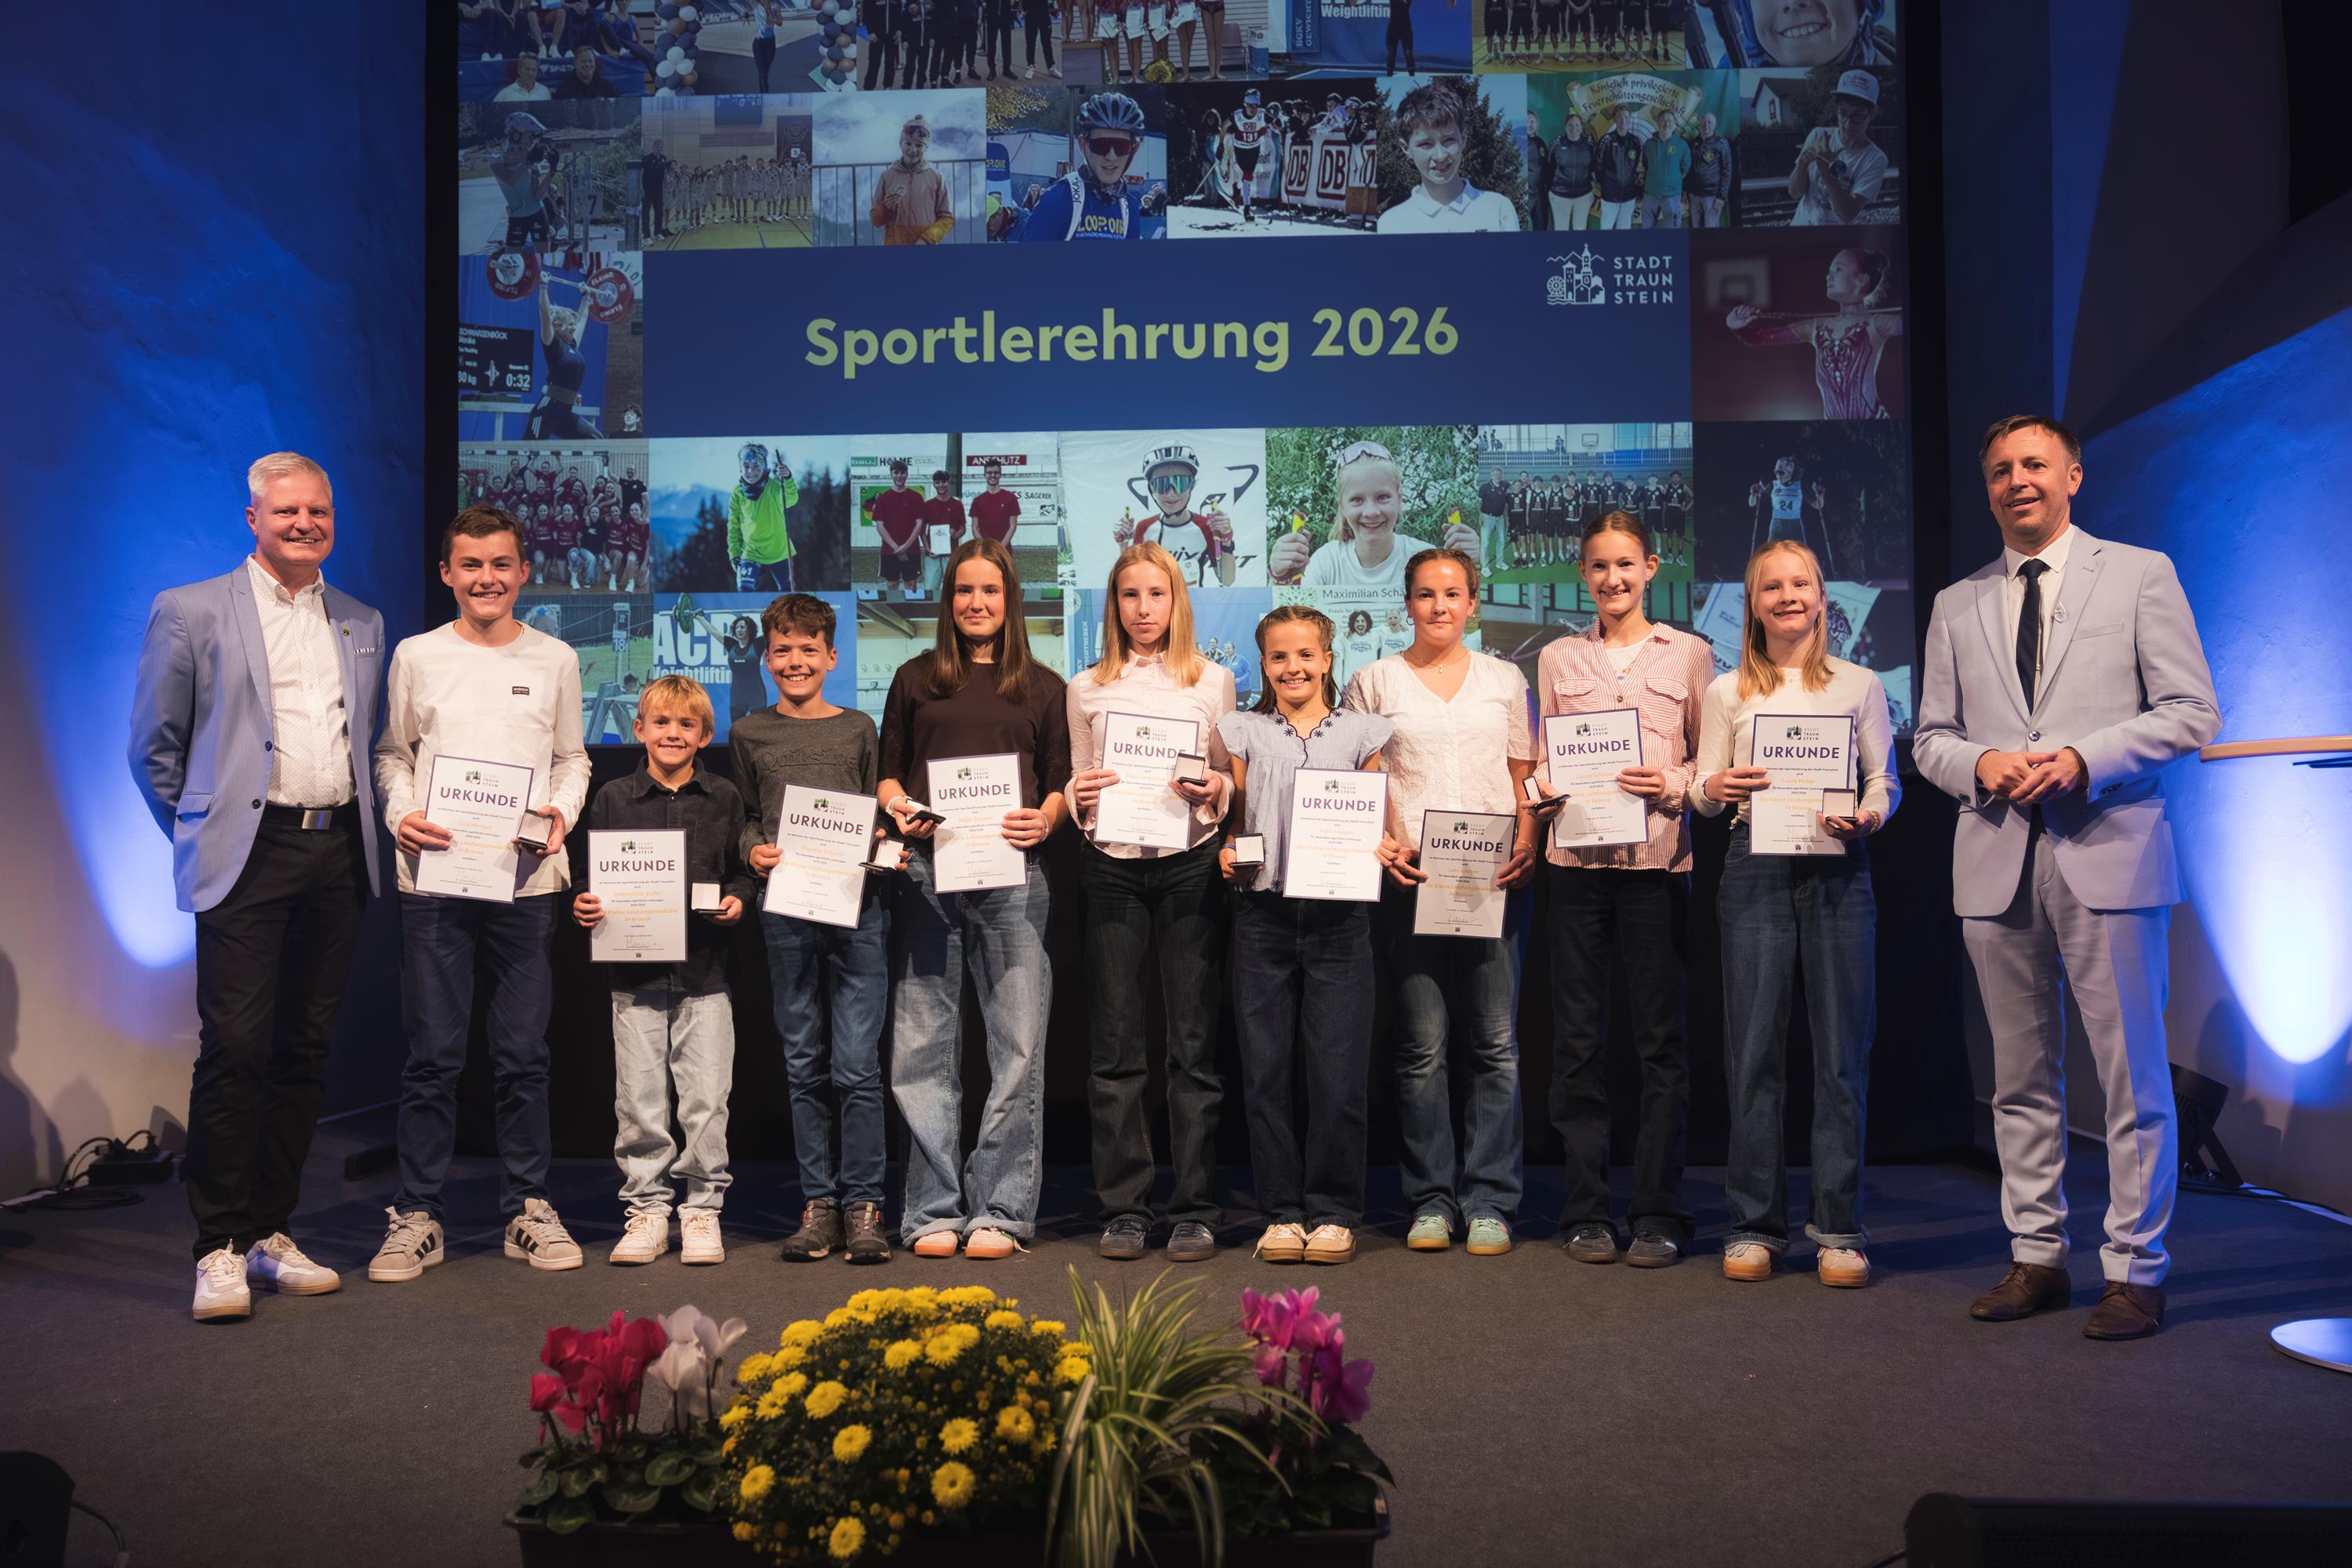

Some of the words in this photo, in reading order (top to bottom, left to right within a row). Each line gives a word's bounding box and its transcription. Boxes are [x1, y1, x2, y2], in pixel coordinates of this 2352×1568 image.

[1320, 5, 1391, 19] Weightliftin
[1590, 78, 1628, 95] Königlich
[1631, 79, 1680, 99] privilegierte
[1582, 91, 1686, 115] Feuerschützengesellschaft
[1243, 133, 1258, 142] 131
[1287, 150, 1308, 186] DB
[1320, 150, 1345, 189] DB
[1613, 256, 1672, 270] STADT
[1613, 273, 1673, 287] TRAUN
[1613, 291, 1673, 304] STEIN
[804, 308, 1290, 379] Sportlerehrung
[1312, 307, 1459, 358] 2026
[506, 372, 531, 388] 0:32
[1780, 501, 1793, 511] 24
[1323, 588, 1378, 599] Maximilian
[1381, 587, 1406, 598] Schä
[613, 638, 626, 652] 18
[653, 666, 732, 684] Weightliftin
[1556, 739, 1631, 756] URKUNDE
[1763, 746, 1839, 759] URKUNDE
[440, 786, 518, 808] URKUNDE
[938, 784, 1011, 800] URKUNDE
[1302, 797, 1376, 811] URKUNDE
[789, 813, 864, 836] URKUNDE
[1431, 838, 1504, 853] URKUNDE
[599, 860, 675, 872] URKUNDE
